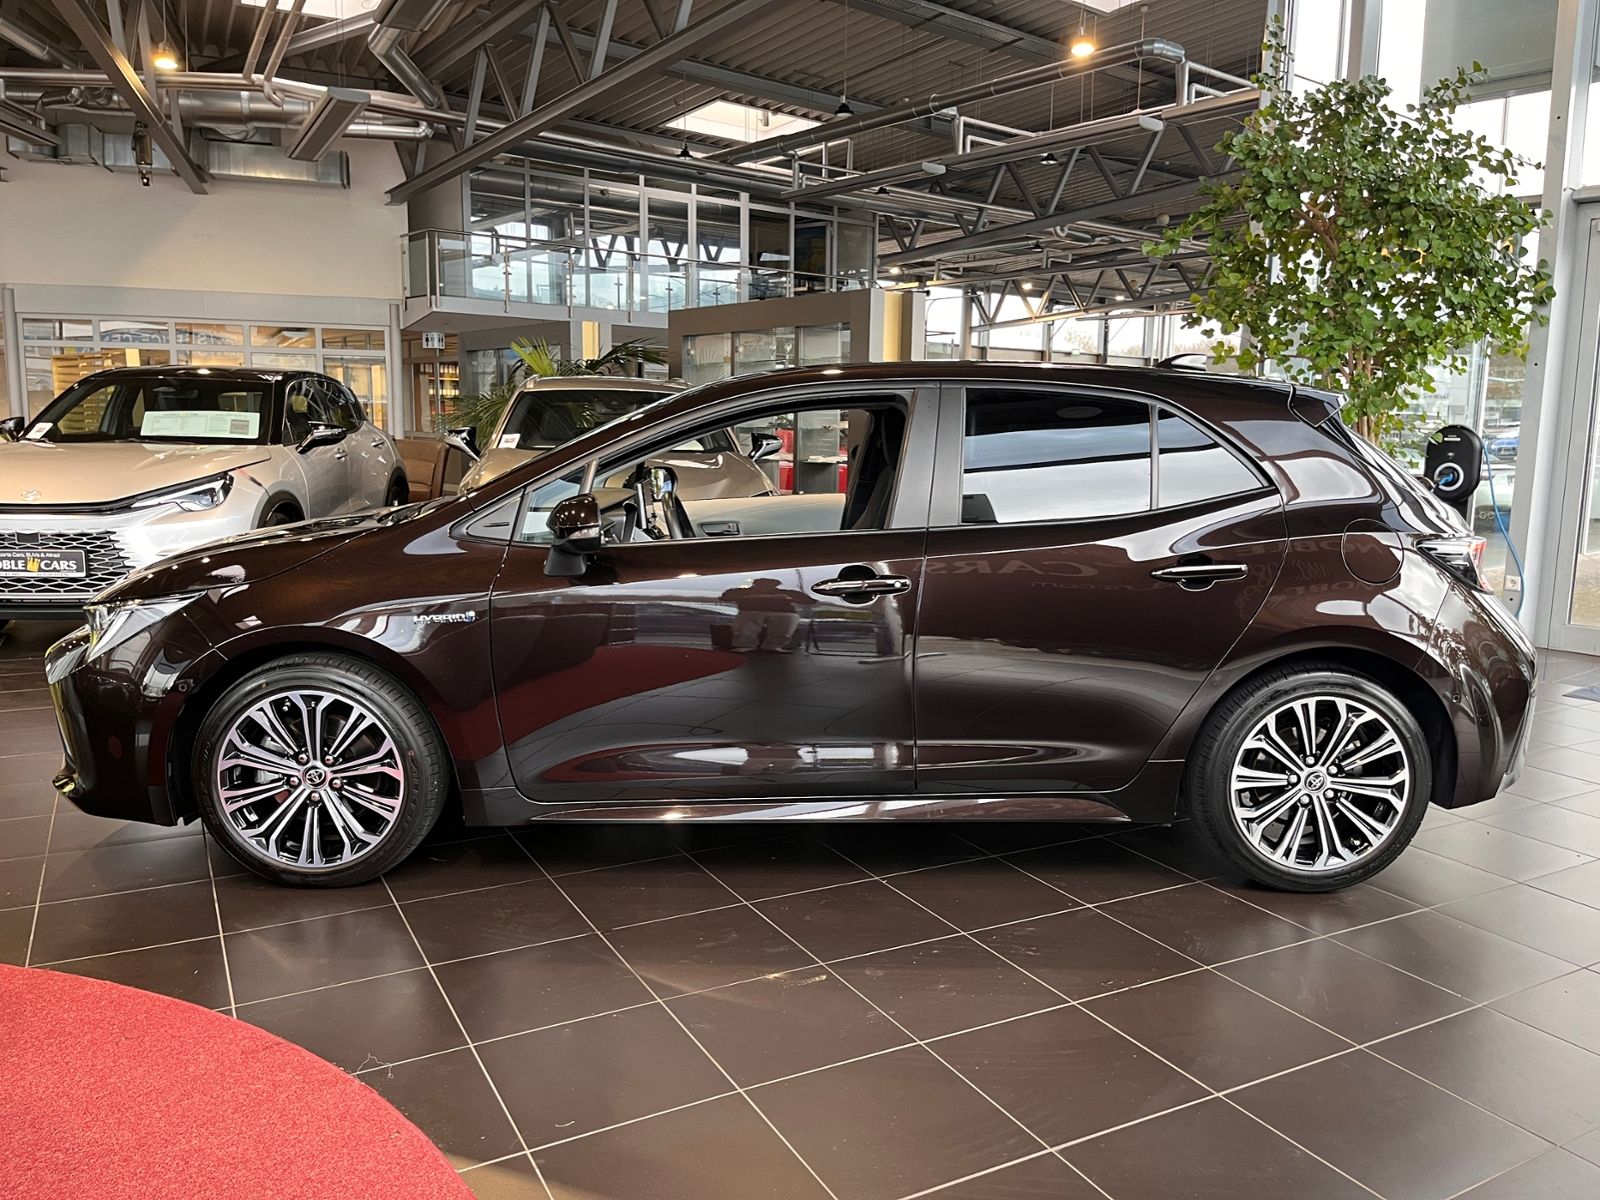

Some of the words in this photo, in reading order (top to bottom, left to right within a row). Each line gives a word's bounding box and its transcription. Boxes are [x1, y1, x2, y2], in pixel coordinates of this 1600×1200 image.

[0, 560, 26, 570] BLE
[40, 560, 77, 570] CARS
[413, 613, 466, 624] HYBRID
